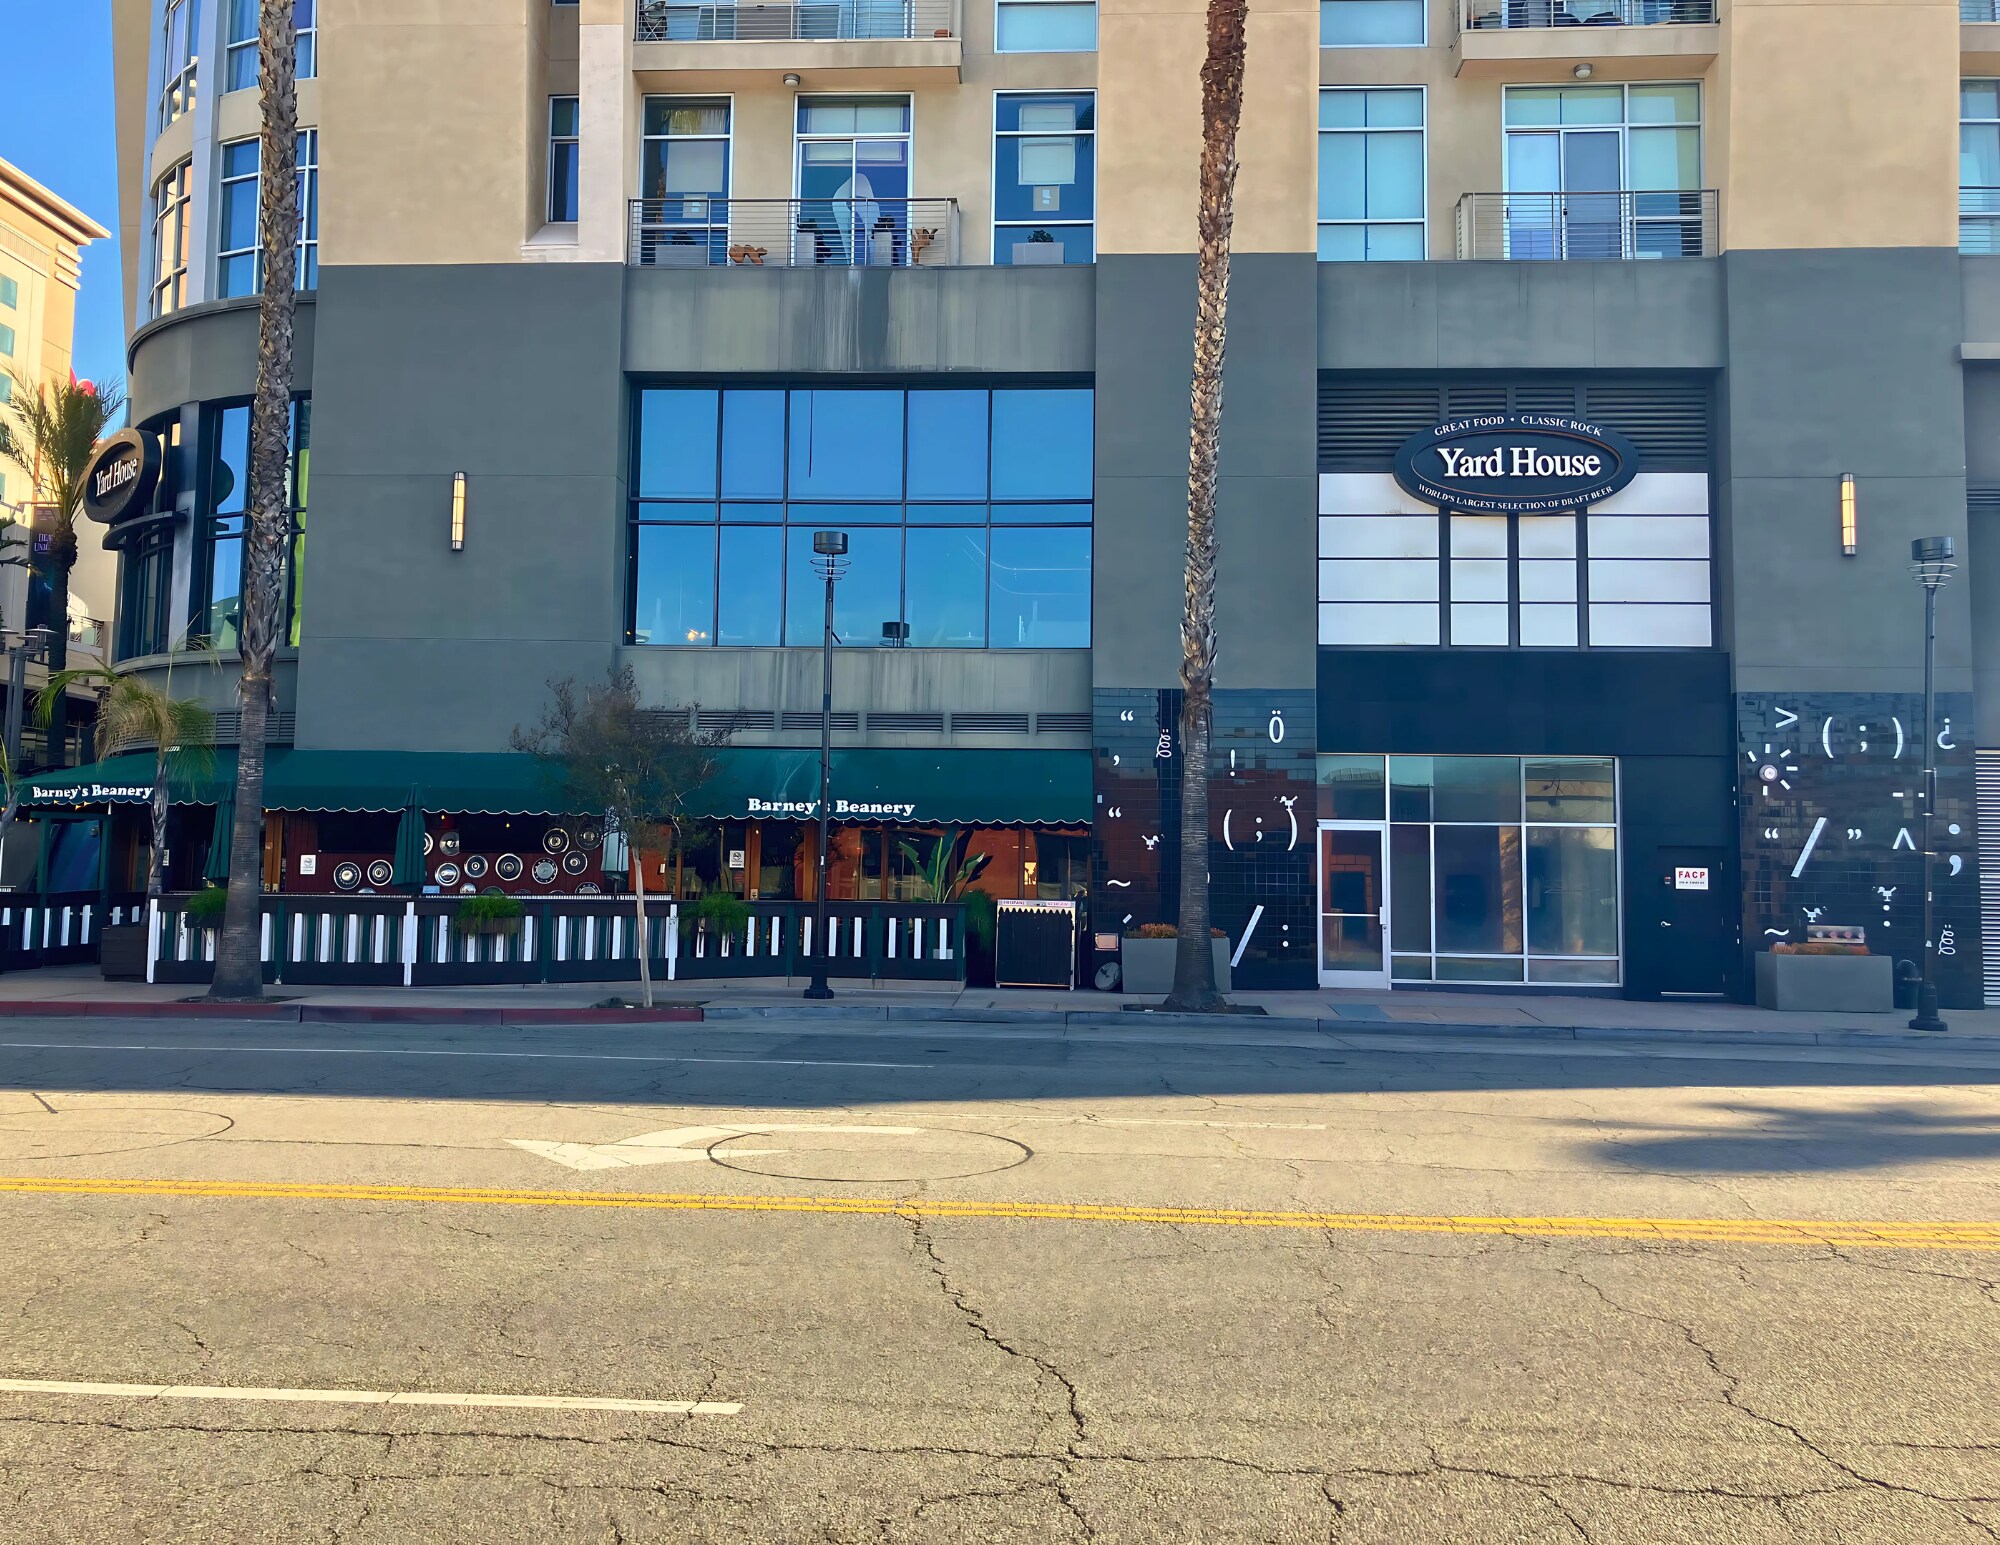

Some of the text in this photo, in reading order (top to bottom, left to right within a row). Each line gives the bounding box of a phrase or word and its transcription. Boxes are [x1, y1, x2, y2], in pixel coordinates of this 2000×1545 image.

[1434, 415, 1603, 437] GREAT FOOD CLASSIC ROCK
[1437, 447, 1601, 477] Yard House
[96, 458, 138, 497] Yard House
[1418, 483, 1613, 510] WORLD'S LARGEST SELECTION OF DRAFT BEER
[32, 784, 153, 800] Barney's Beanery
[835, 799, 915, 816] Beanery
[1678, 871, 1705, 879] FACP
